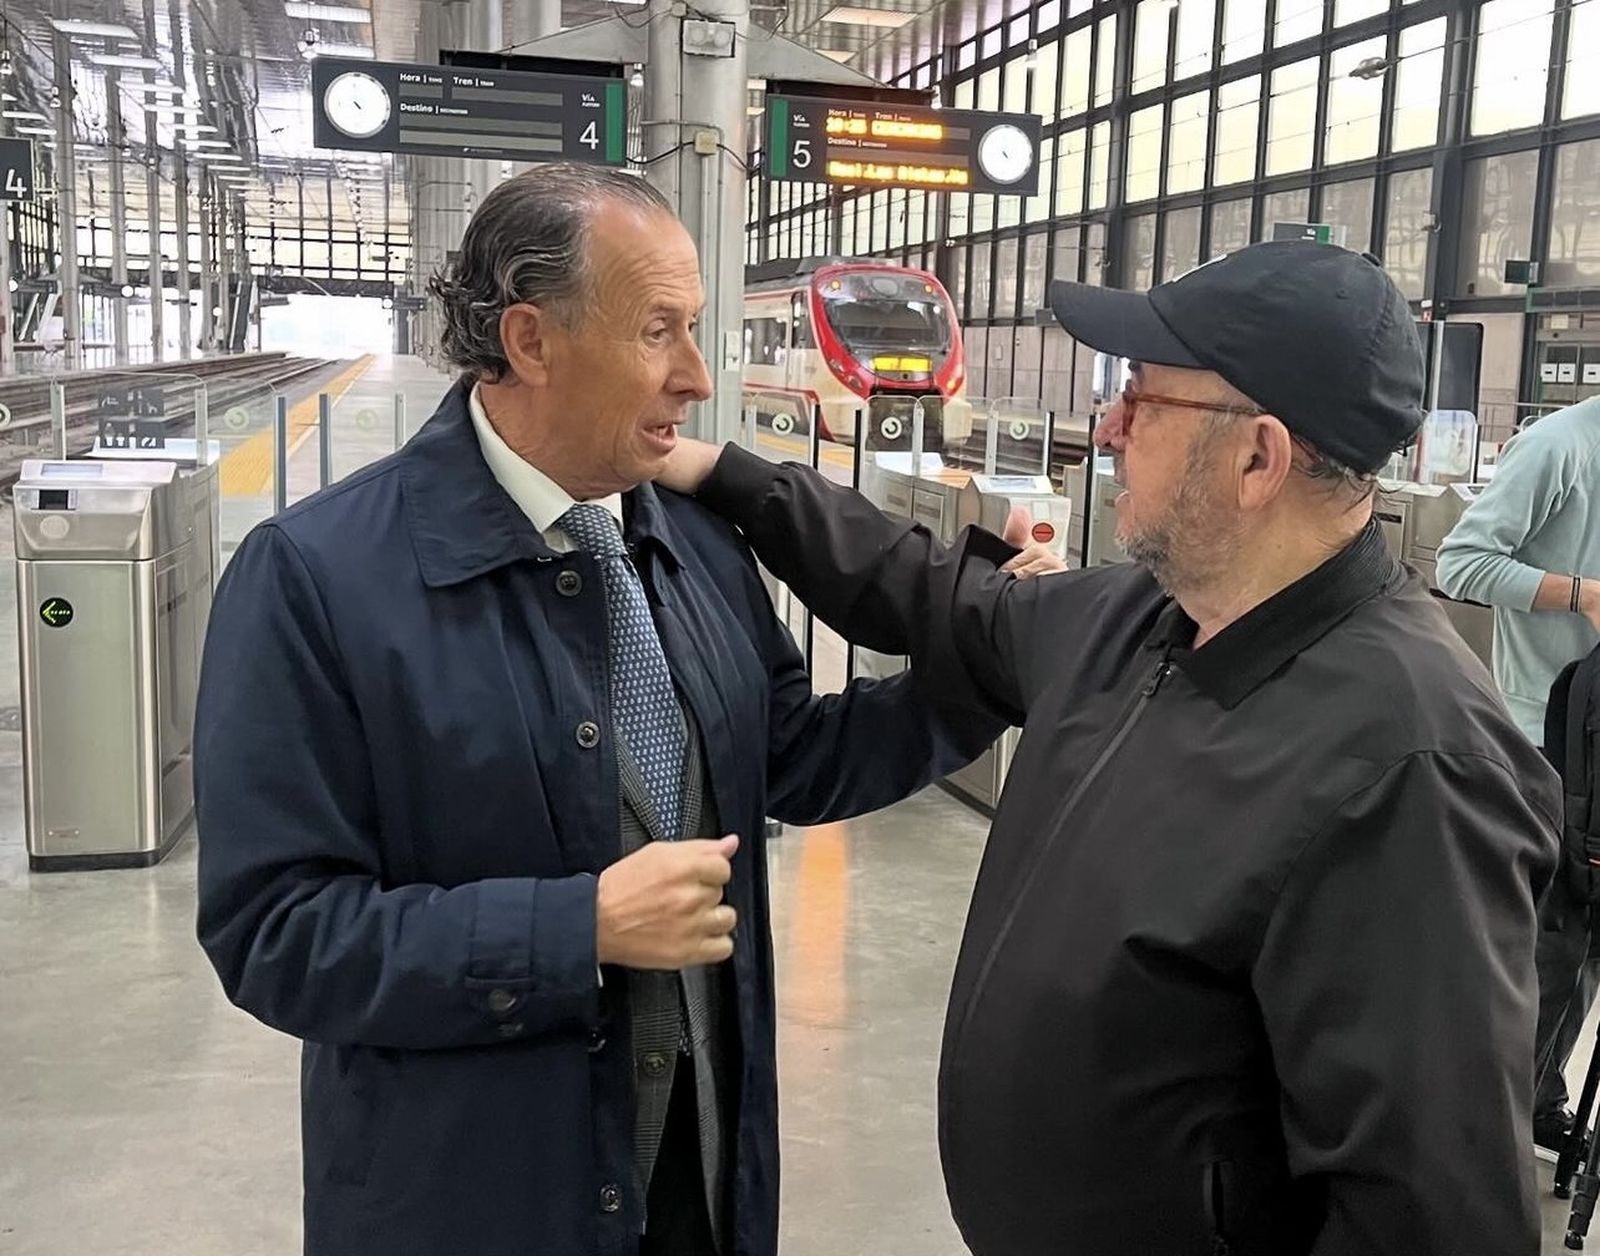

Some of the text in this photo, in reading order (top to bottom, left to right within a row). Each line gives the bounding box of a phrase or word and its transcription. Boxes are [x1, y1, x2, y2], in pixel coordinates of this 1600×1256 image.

[400, 73, 420, 82] Hora
[453, 76, 473, 85] Tren
[400, 103, 433, 113] Destino
[579, 121, 600, 150] 4
[793, 140, 811, 168] 5
[5, 168, 28, 198] 4
